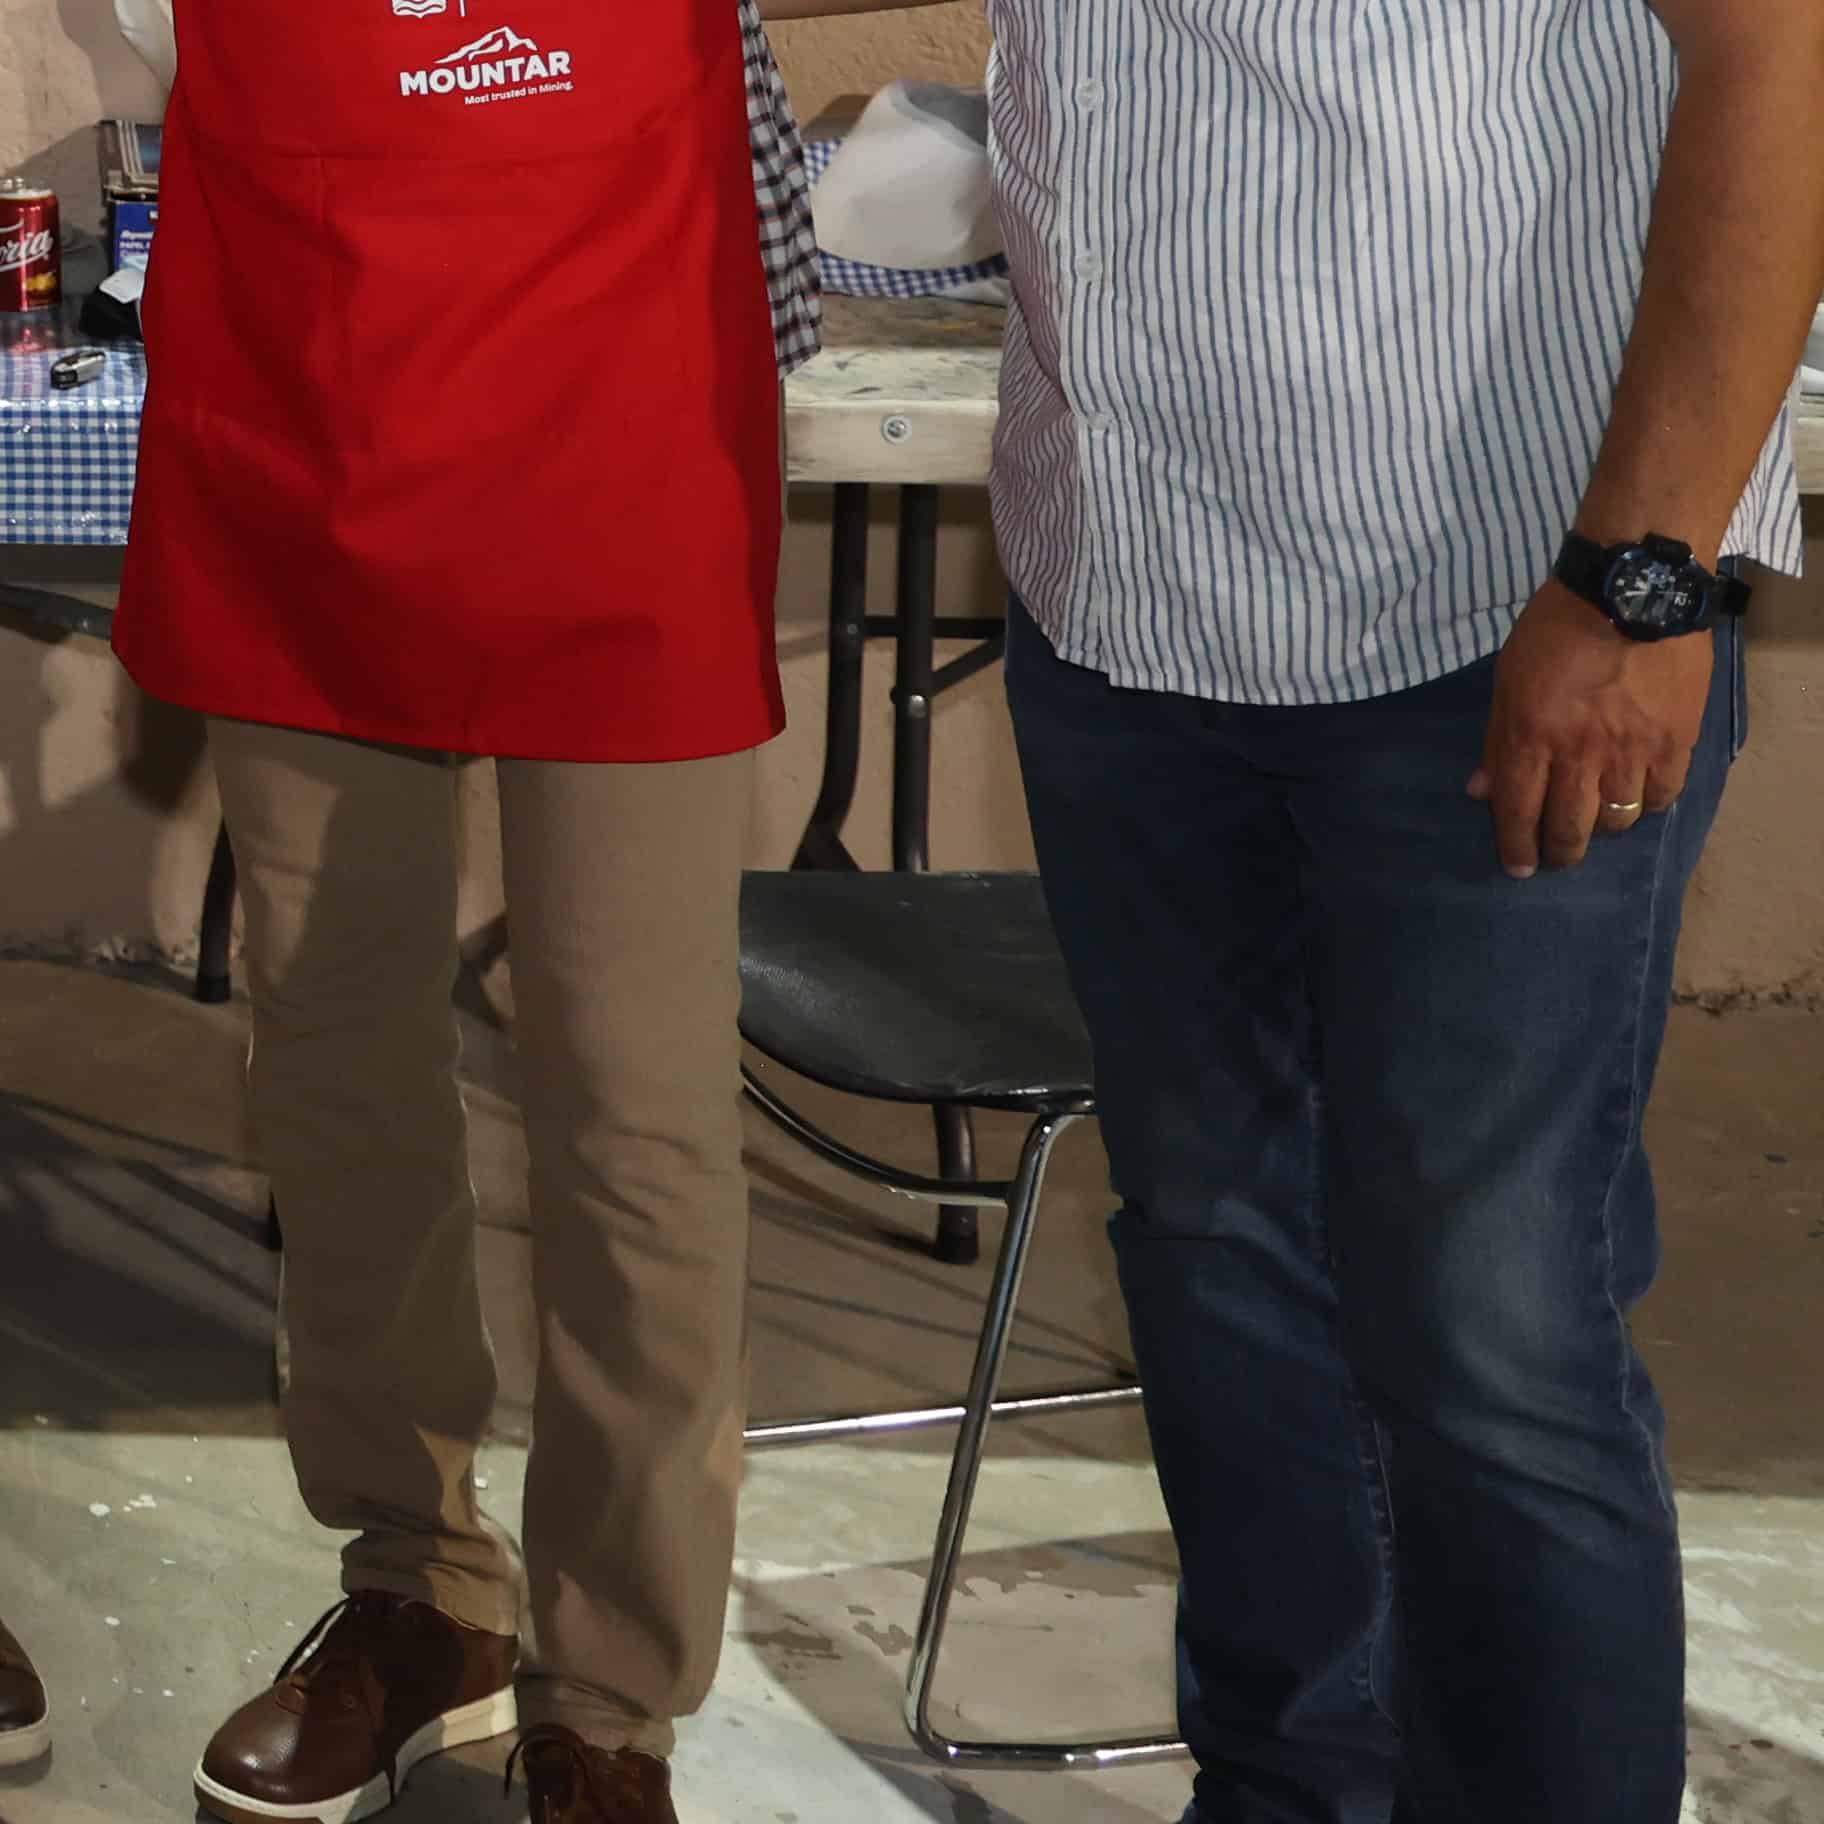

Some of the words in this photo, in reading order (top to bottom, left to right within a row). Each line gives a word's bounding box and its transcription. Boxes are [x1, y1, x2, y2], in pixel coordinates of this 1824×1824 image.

[399, 51, 571, 96] MOUNTAR
[464, 94, 489, 105] Most
[491, 88, 526, 101] trusted
[528, 87, 538, 96] in
